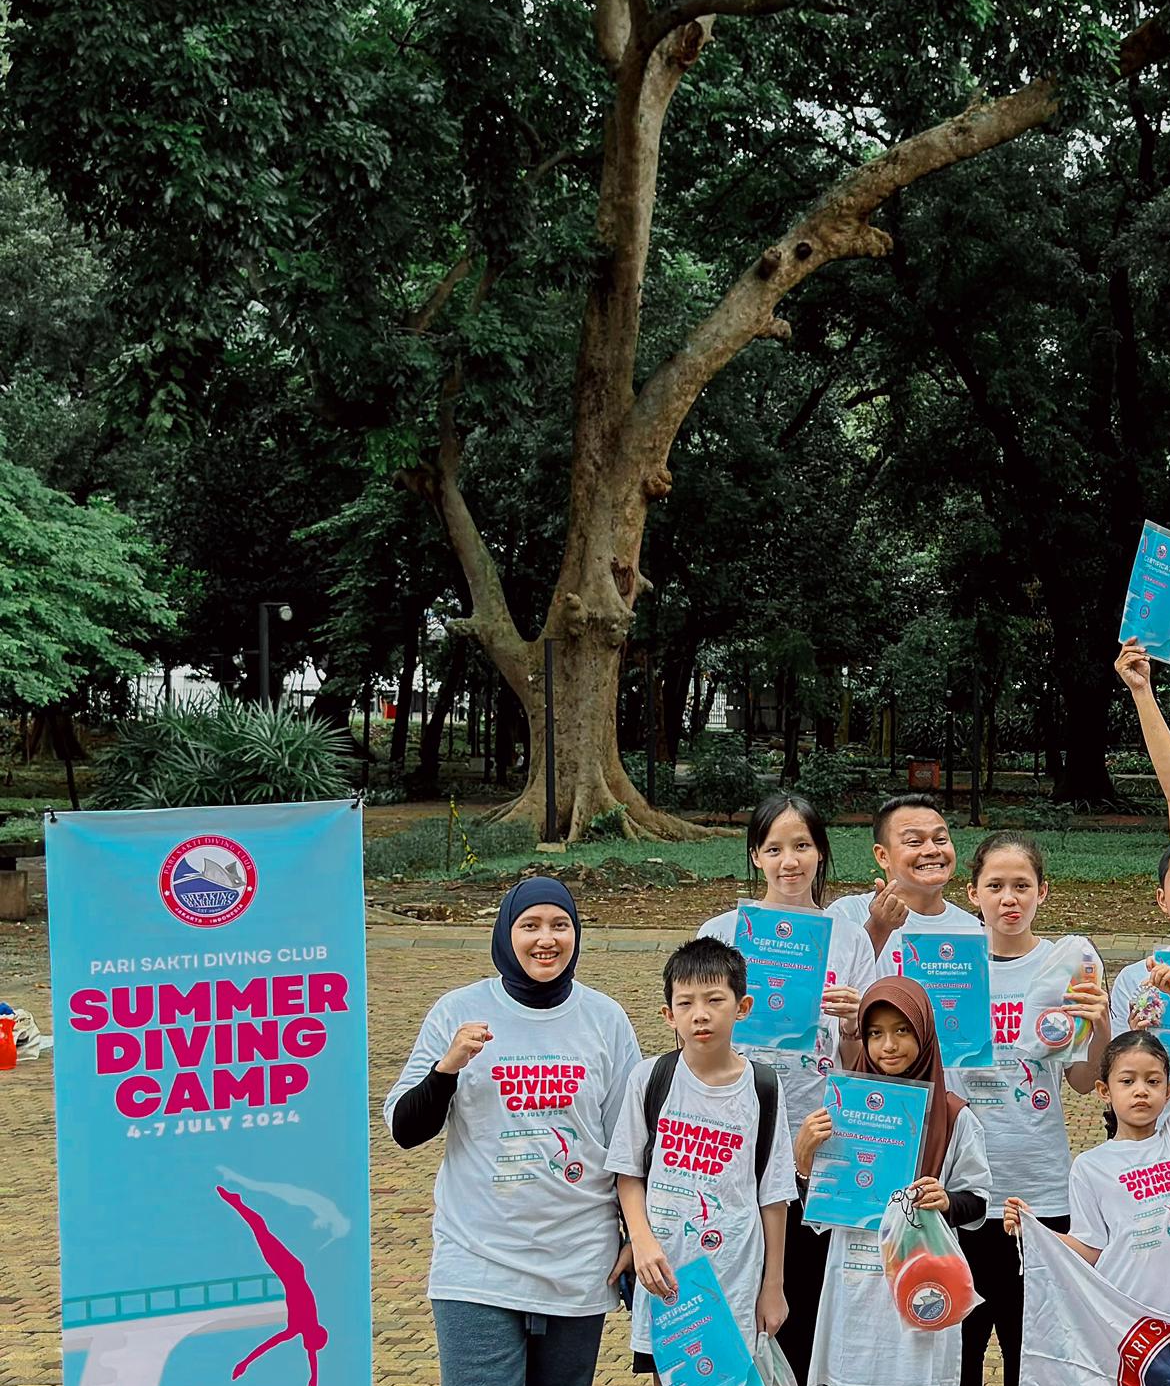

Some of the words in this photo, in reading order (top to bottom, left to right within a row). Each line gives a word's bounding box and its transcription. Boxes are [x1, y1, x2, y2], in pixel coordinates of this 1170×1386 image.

[753, 937, 810, 952] CERTIFICATE
[90, 960, 135, 975] PARI
[140, 954, 199, 973] SAKTI
[204, 949, 272, 968] DIVING
[277, 945, 328, 963] CLUB
[921, 962, 973, 971] CERTIFICATE
[68, 972, 350, 1032] SUMMER
[95, 1016, 328, 1075] DIVING
[491, 1064, 586, 1080] SUMMER
[114, 1062, 310, 1119] CAMP
[500, 1079, 579, 1095] DIVING
[506, 1095, 573, 1111] CAMP
[842, 1109, 903, 1126] CERTIFICATE
[126, 1121, 166, 1138] 4-7
[174, 1115, 233, 1136] JULY
[241, 1109, 300, 1128] 2024
[658, 1118, 744, 1150] SUMMER
[661, 1134, 733, 1163] DIVING
[663, 1151, 724, 1176] CAMP
[655, 1294, 704, 1326] CERTIFICATE
